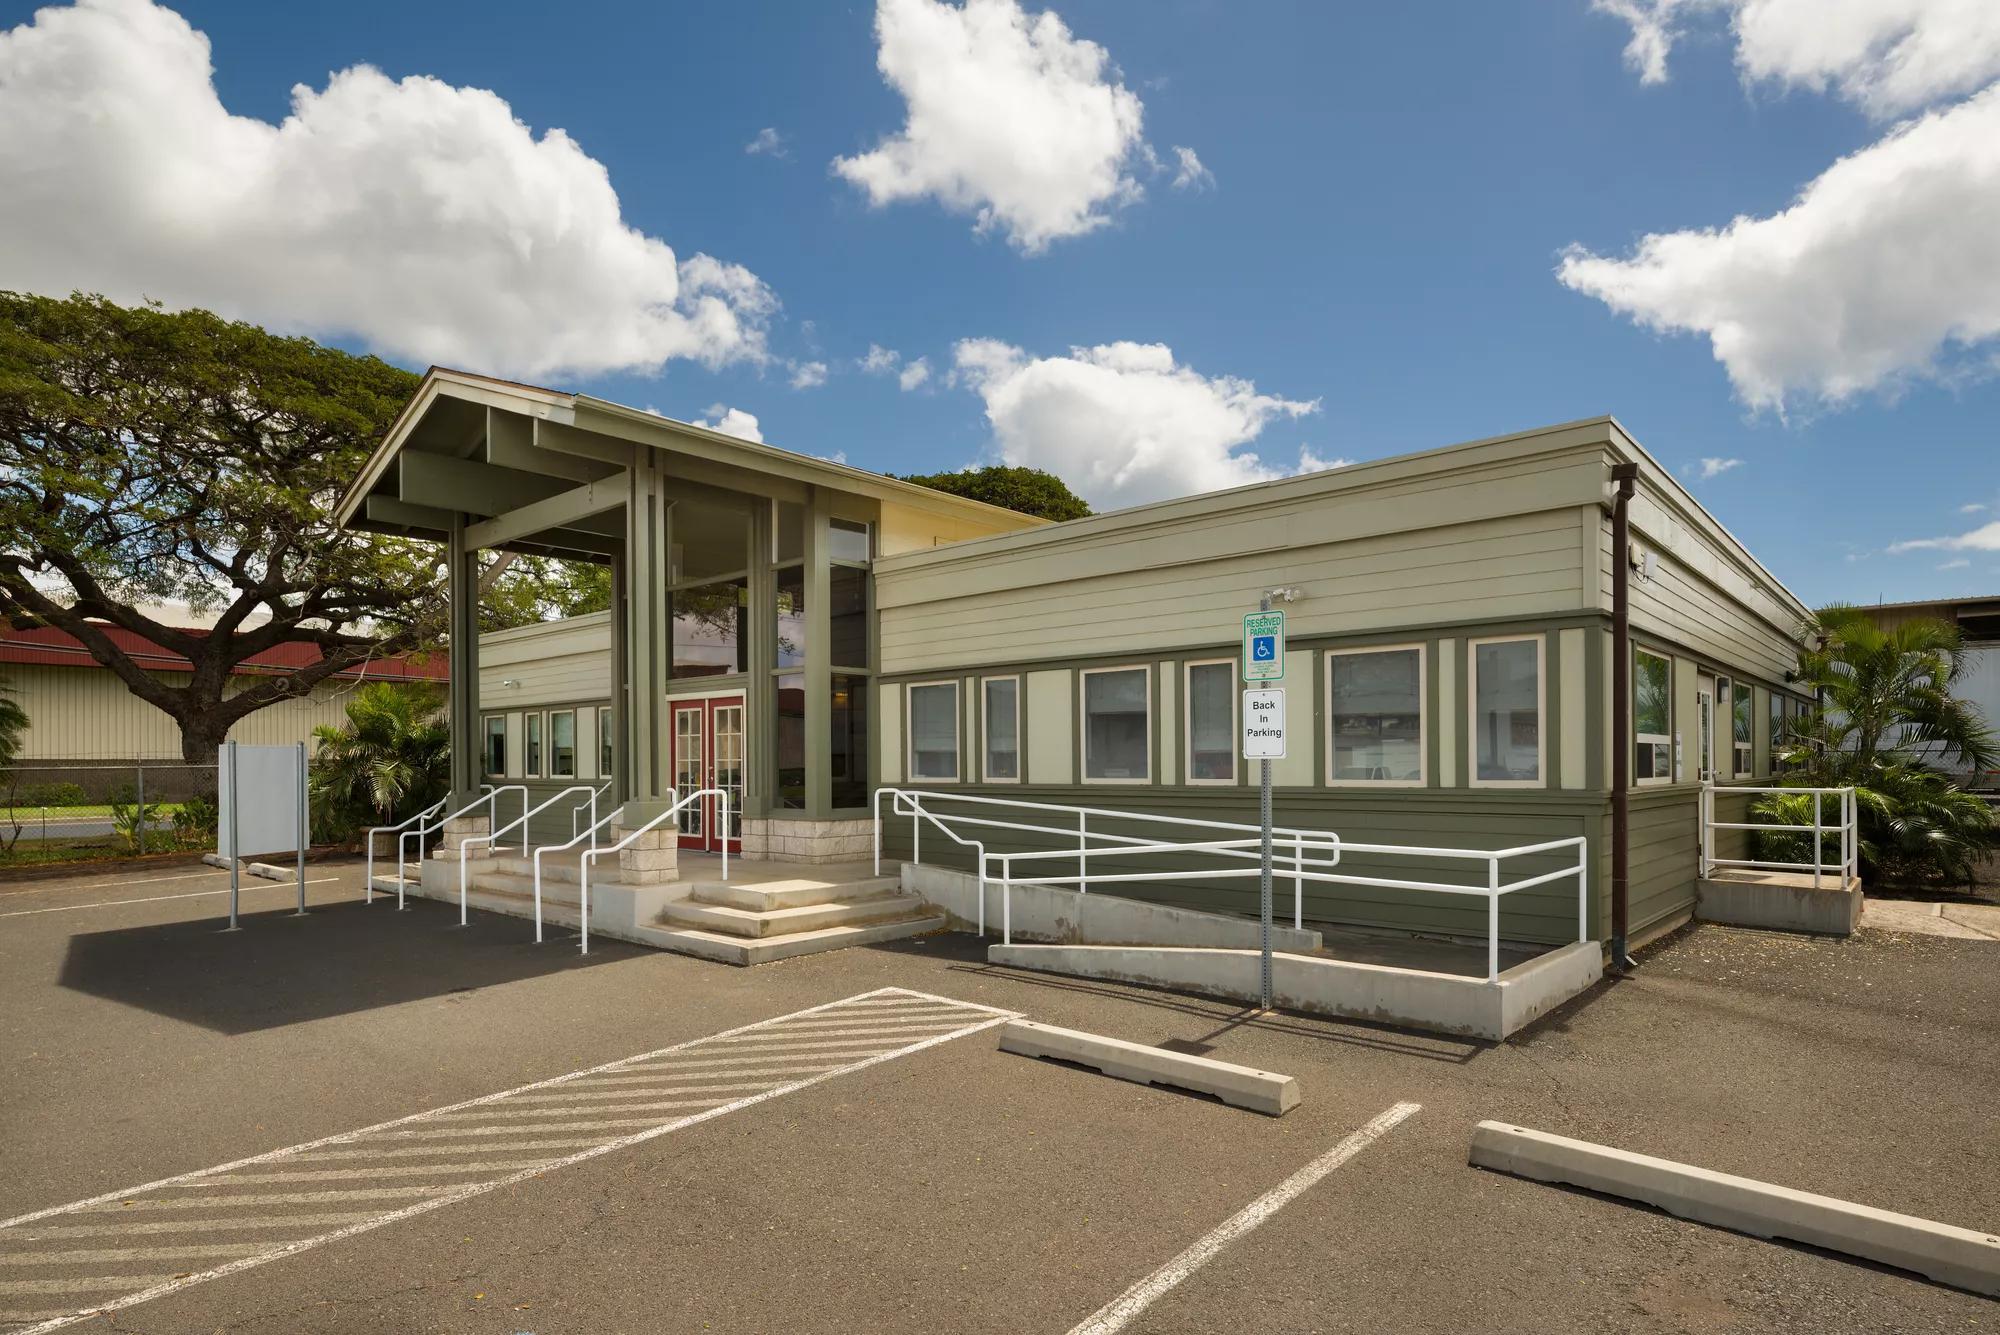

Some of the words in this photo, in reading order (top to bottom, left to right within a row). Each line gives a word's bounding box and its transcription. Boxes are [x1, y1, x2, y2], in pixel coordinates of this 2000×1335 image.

[1247, 617, 1281, 628] RESERVED
[1250, 626, 1278, 636] PARKING
[1253, 701, 1275, 710] Back
[1259, 715, 1268, 723] In
[1247, 728, 1282, 739] Parking
